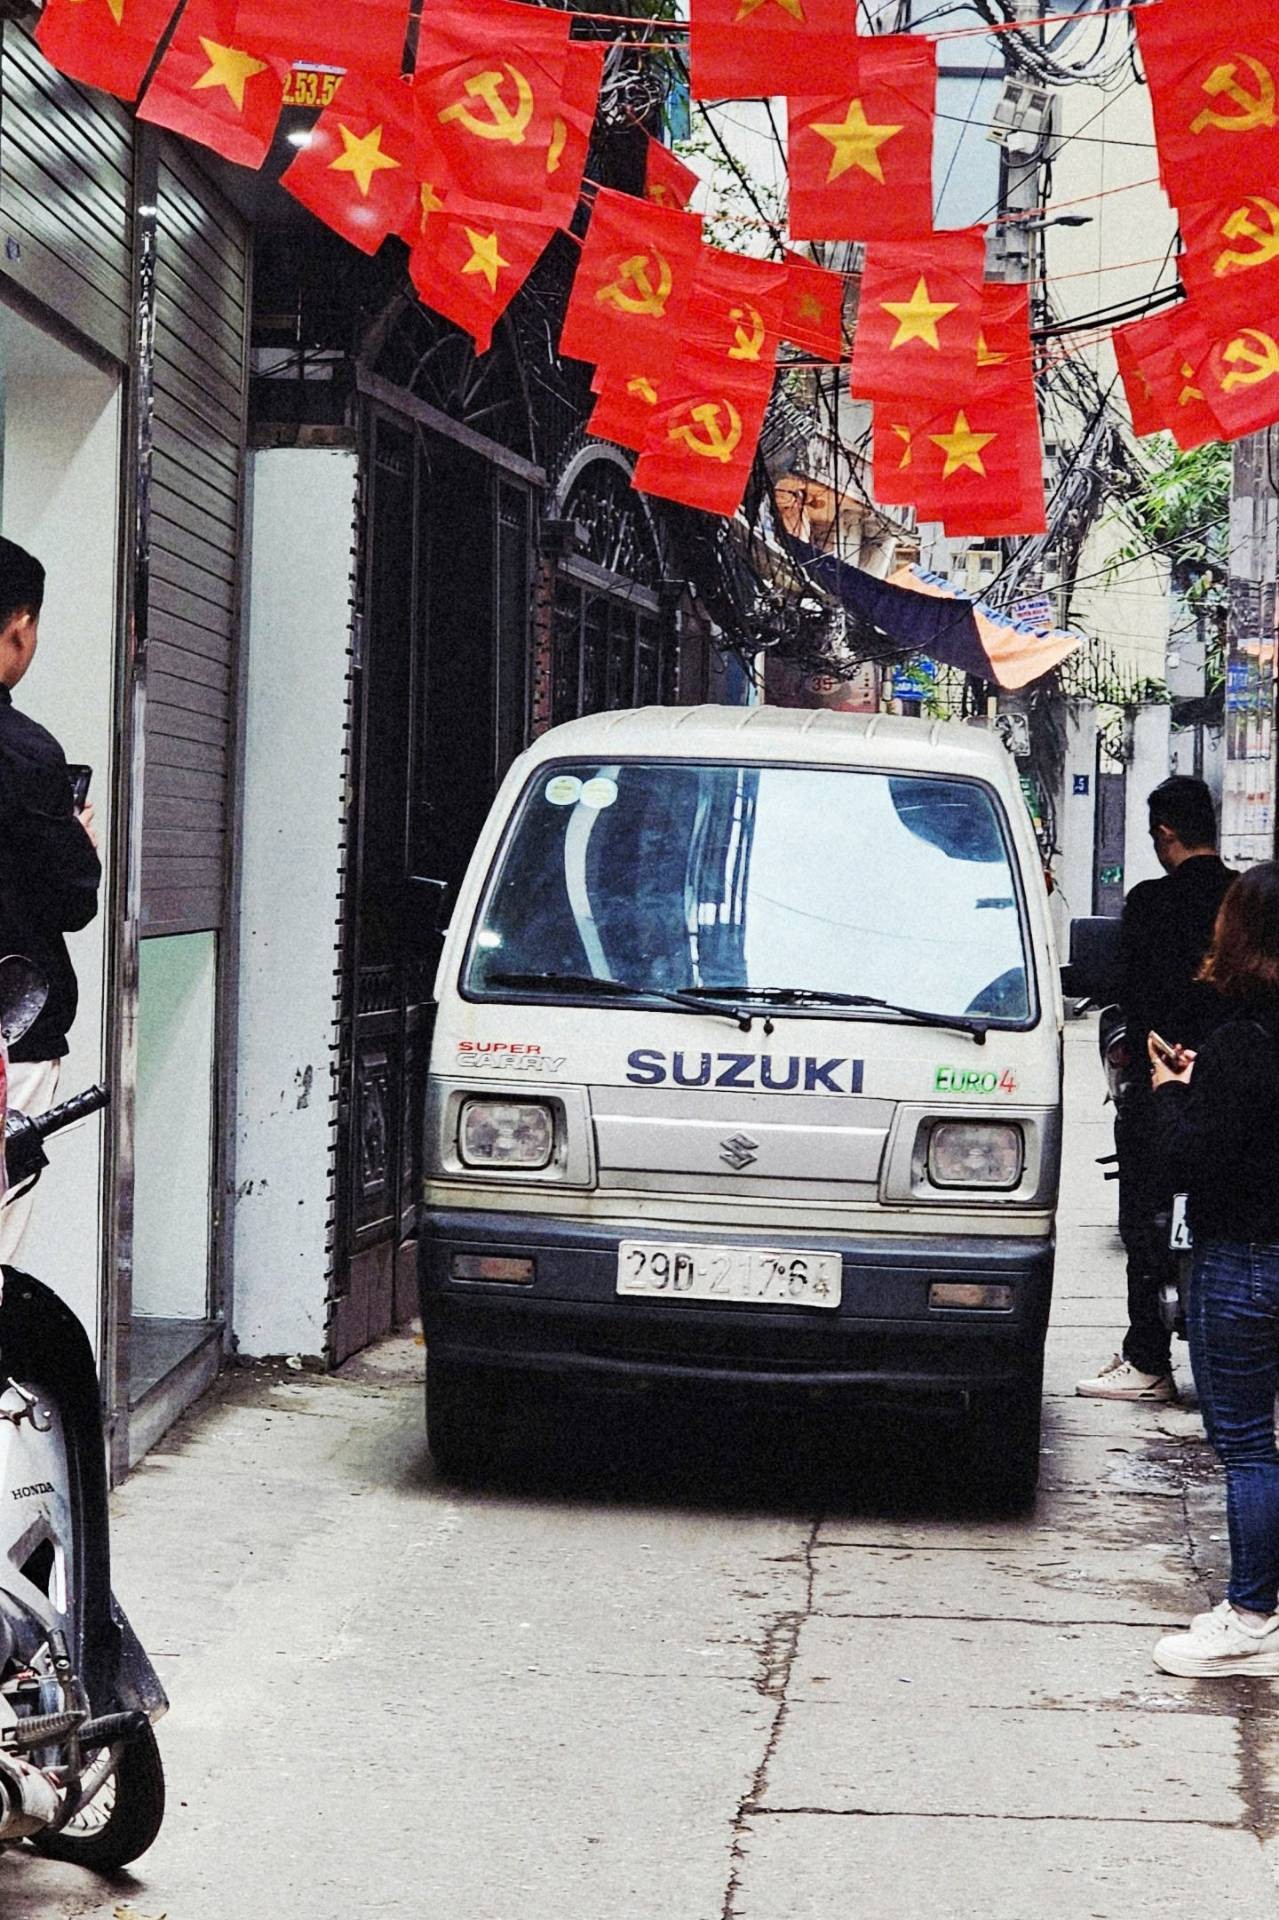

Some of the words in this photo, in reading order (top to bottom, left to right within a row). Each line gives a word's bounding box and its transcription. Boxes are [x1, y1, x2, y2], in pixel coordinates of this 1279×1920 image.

[459, 1041, 541, 1055] SUPER
[456, 1052, 567, 1072] CARRY
[626, 1048, 865, 1094] SUZUKI
[11, 1481, 55, 1500] HONDA
